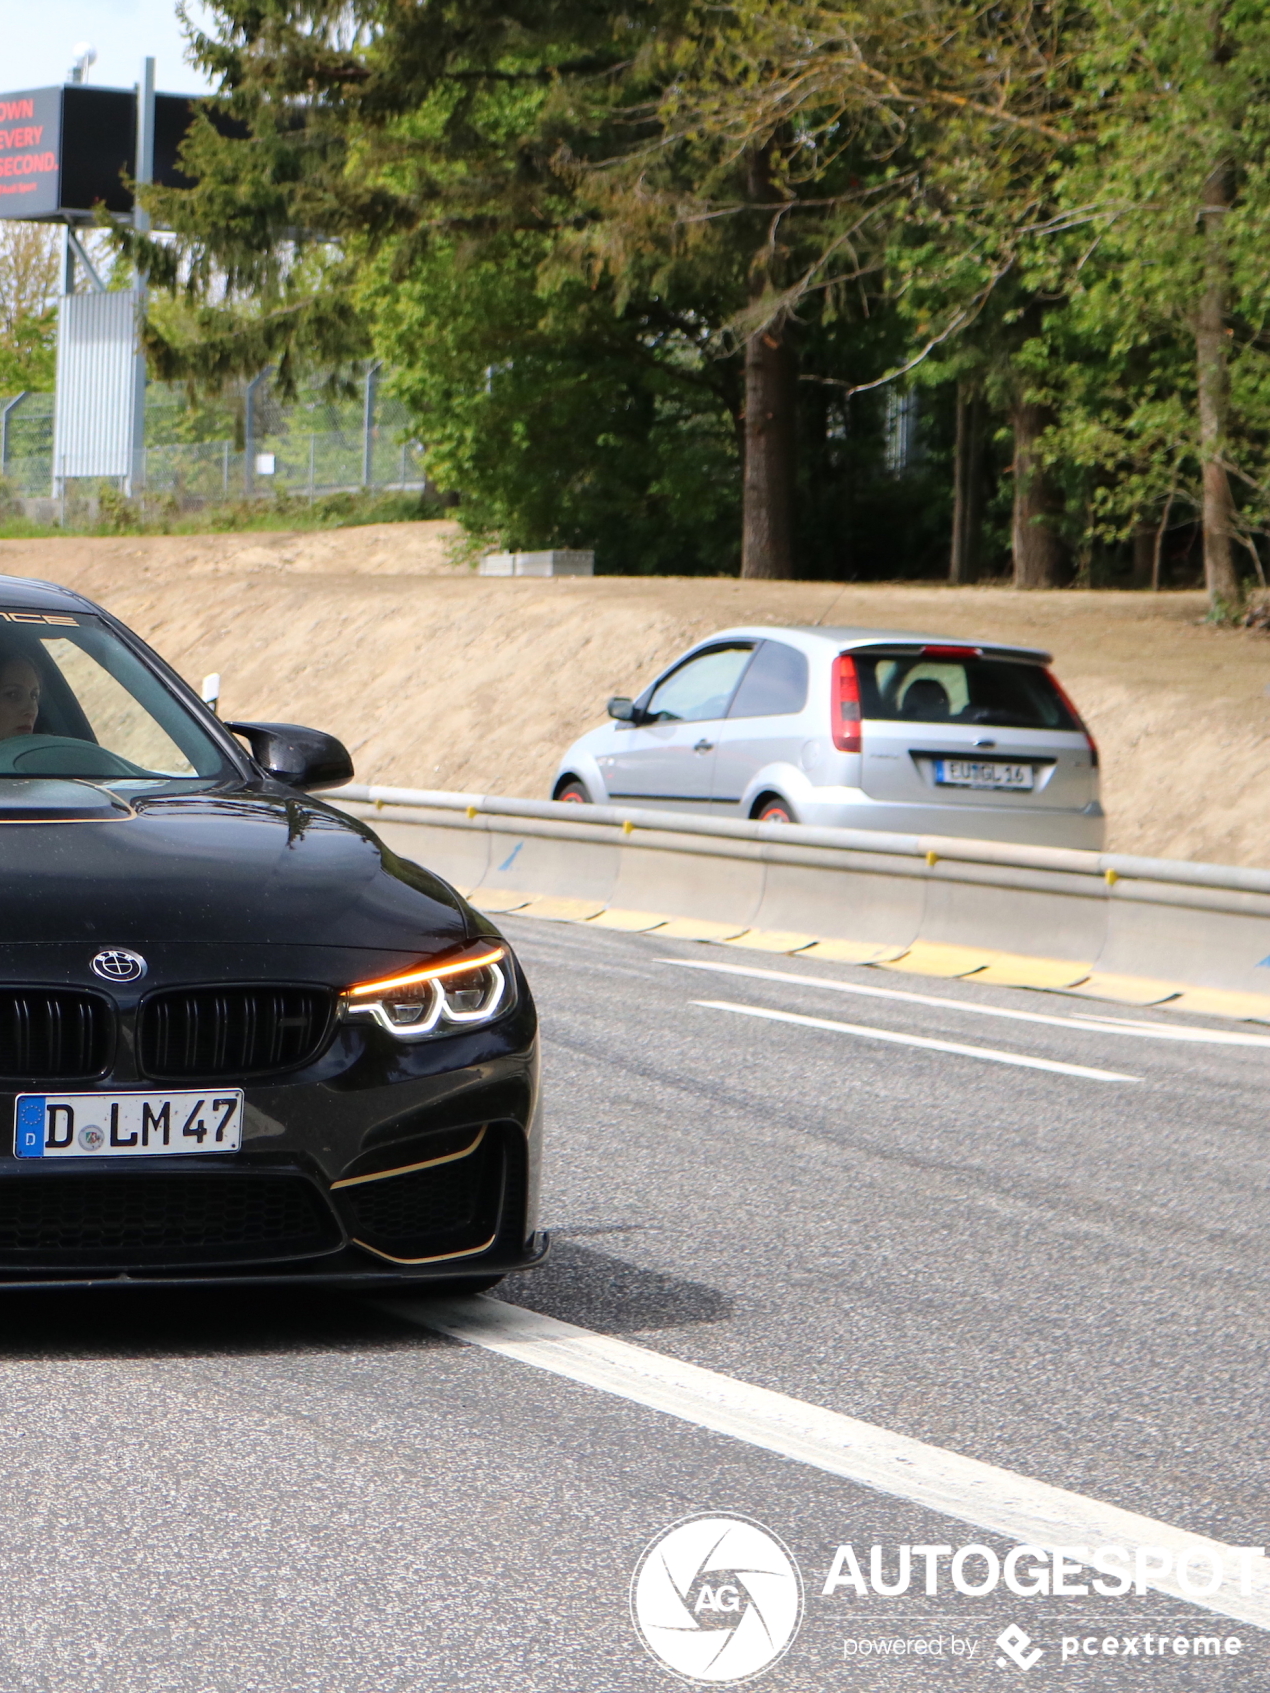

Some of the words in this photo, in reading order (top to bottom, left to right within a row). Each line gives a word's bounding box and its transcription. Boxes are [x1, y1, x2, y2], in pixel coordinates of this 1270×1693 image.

[950, 763, 970, 780] EU
[44, 1104, 74, 1148] D
[110, 1102, 171, 1147] LM
[182, 1099, 238, 1144] 47
[25, 1133, 36, 1146] D
